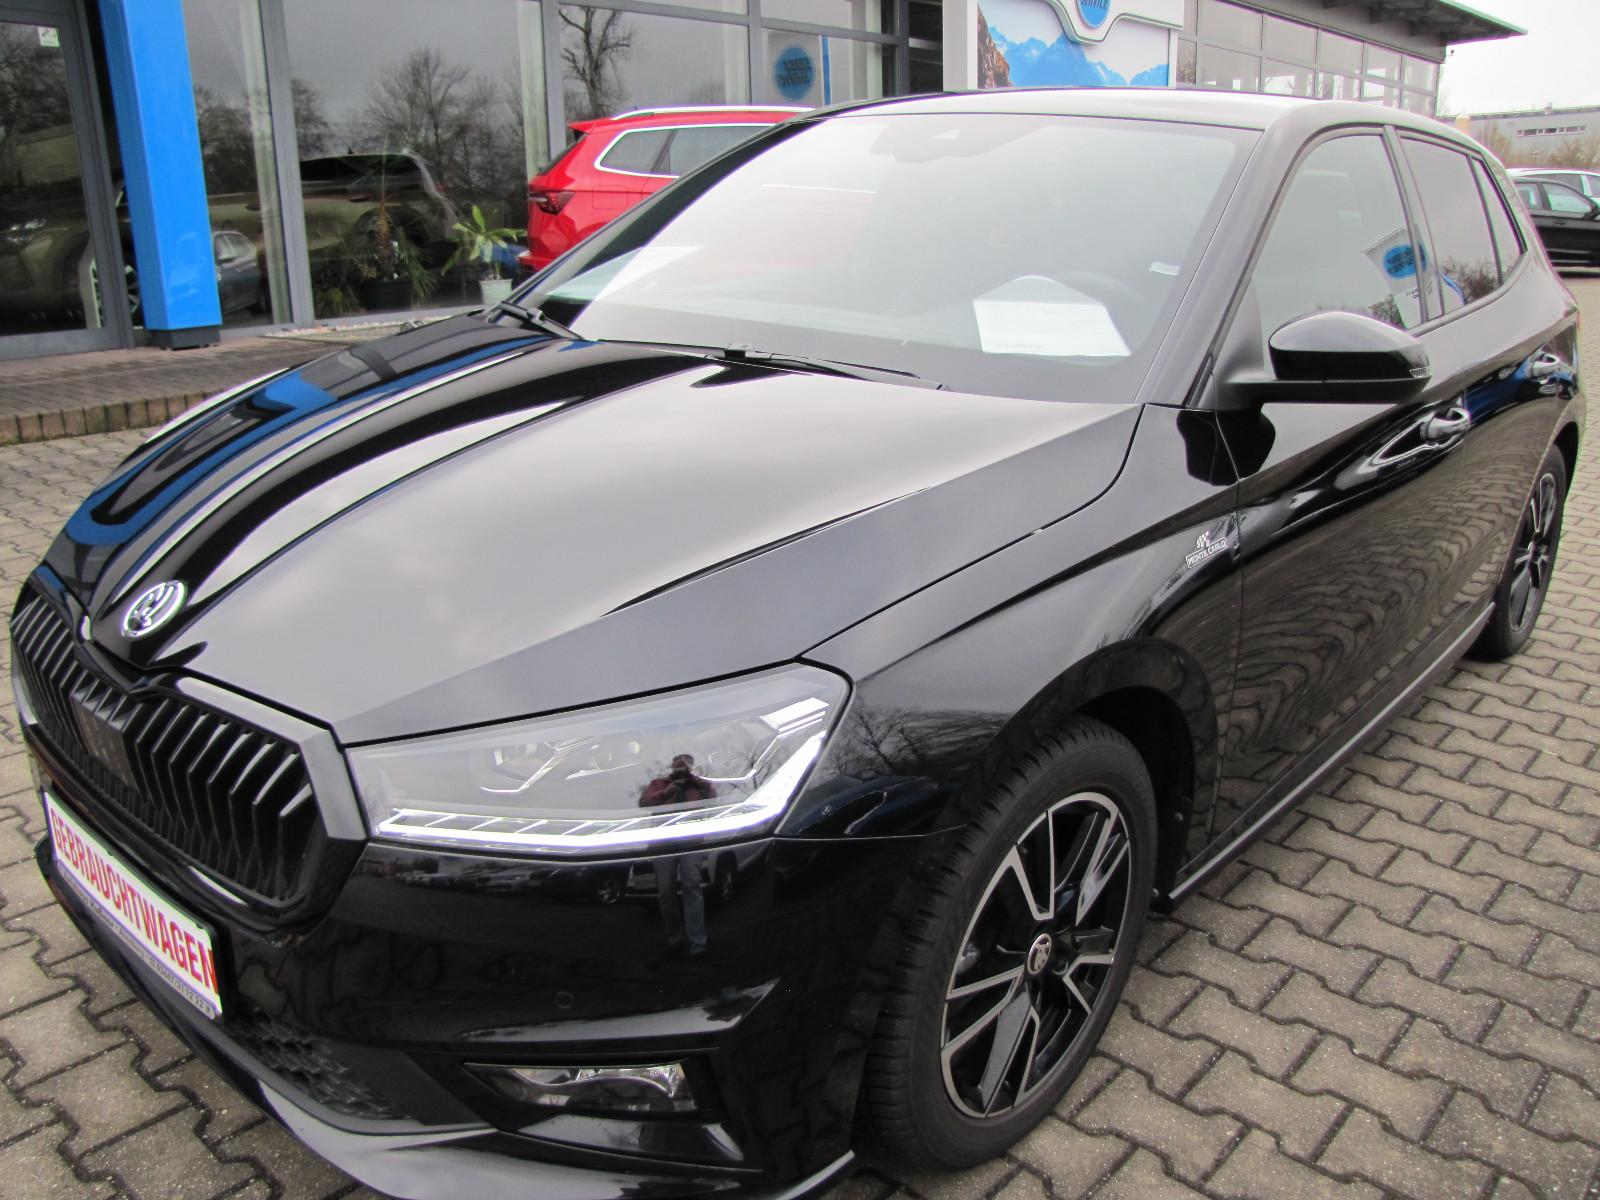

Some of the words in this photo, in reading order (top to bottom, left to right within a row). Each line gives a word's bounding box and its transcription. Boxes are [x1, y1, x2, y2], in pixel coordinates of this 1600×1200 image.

[1187, 549, 1208, 566] MONTE
[1207, 540, 1226, 555] CARLO
[51, 807, 219, 994] GEBRAUCHTWAGEN
